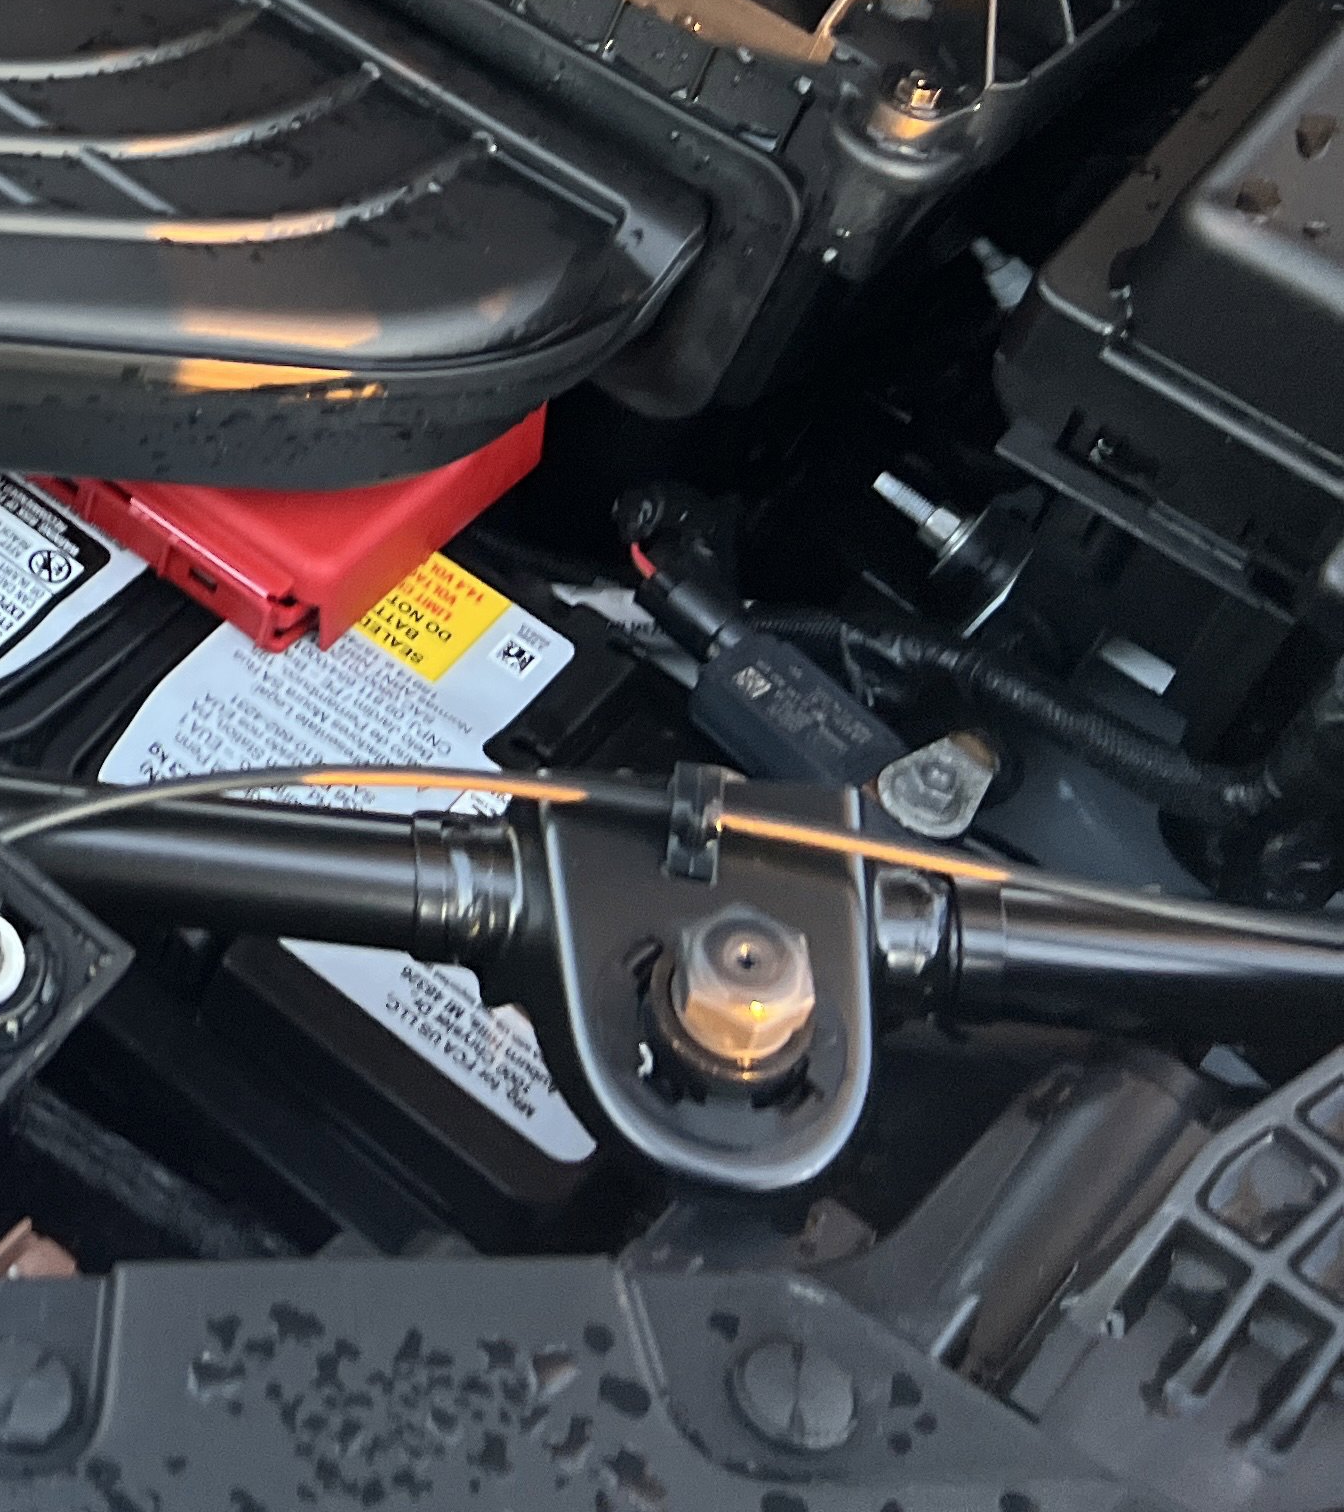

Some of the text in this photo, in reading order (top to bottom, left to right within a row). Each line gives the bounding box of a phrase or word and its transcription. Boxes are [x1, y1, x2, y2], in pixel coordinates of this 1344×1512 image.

[412, 589, 454, 623] LIMIT
[452, 577, 487, 605] 14.4
[369, 601, 421, 642] BATT
[383, 591, 454, 644] DO NOT
[414, 1020, 444, 1047] US
[431, 1009, 499, 1067] Chrysler
[439, 1038, 478, 1073] FCA
